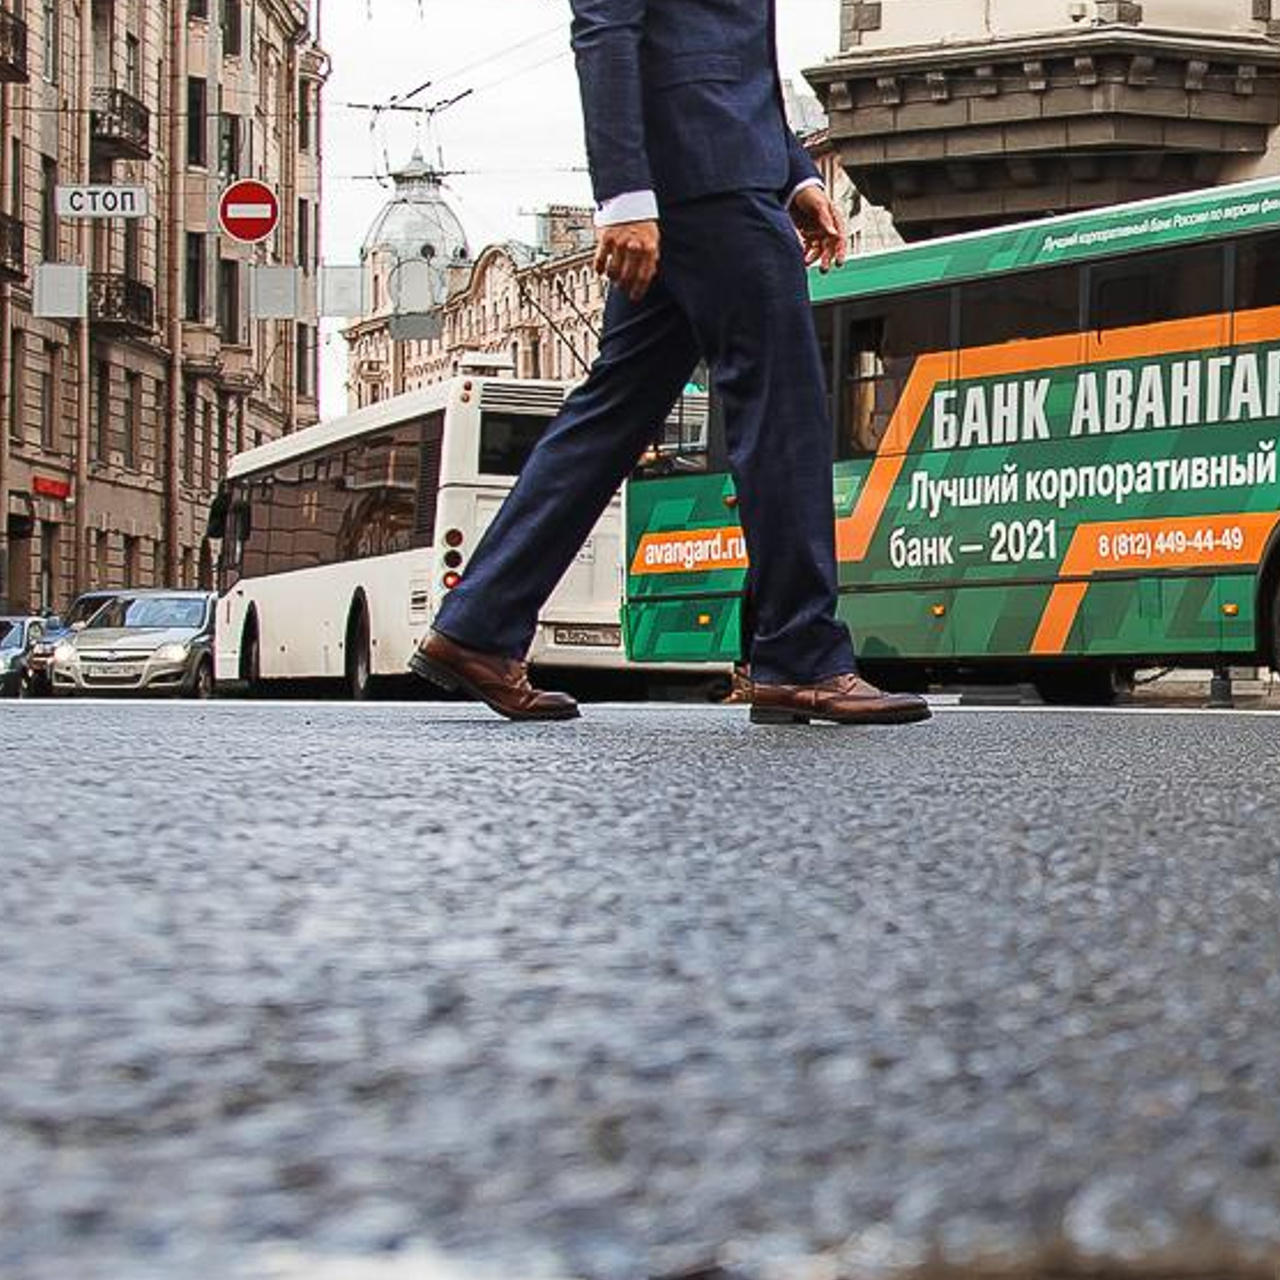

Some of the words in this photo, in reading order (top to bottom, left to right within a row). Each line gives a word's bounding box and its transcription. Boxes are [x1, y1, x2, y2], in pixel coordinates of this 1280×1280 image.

[70, 191, 135, 212] СТОП
[931, 378, 1051, 450] БАНК
[906, 463, 1018, 518] Лучший
[1026, 440, 1277, 508] корпоративный
[645, 532, 747, 569] avangard.ru
[889, 529, 953, 569] банк
[989, 520, 1058, 563] 2021
[1098, 538, 1108, 558] 8
[1112, 532, 1152, 561] (812)
[1155, 527, 1244, 555] 449-44-49
